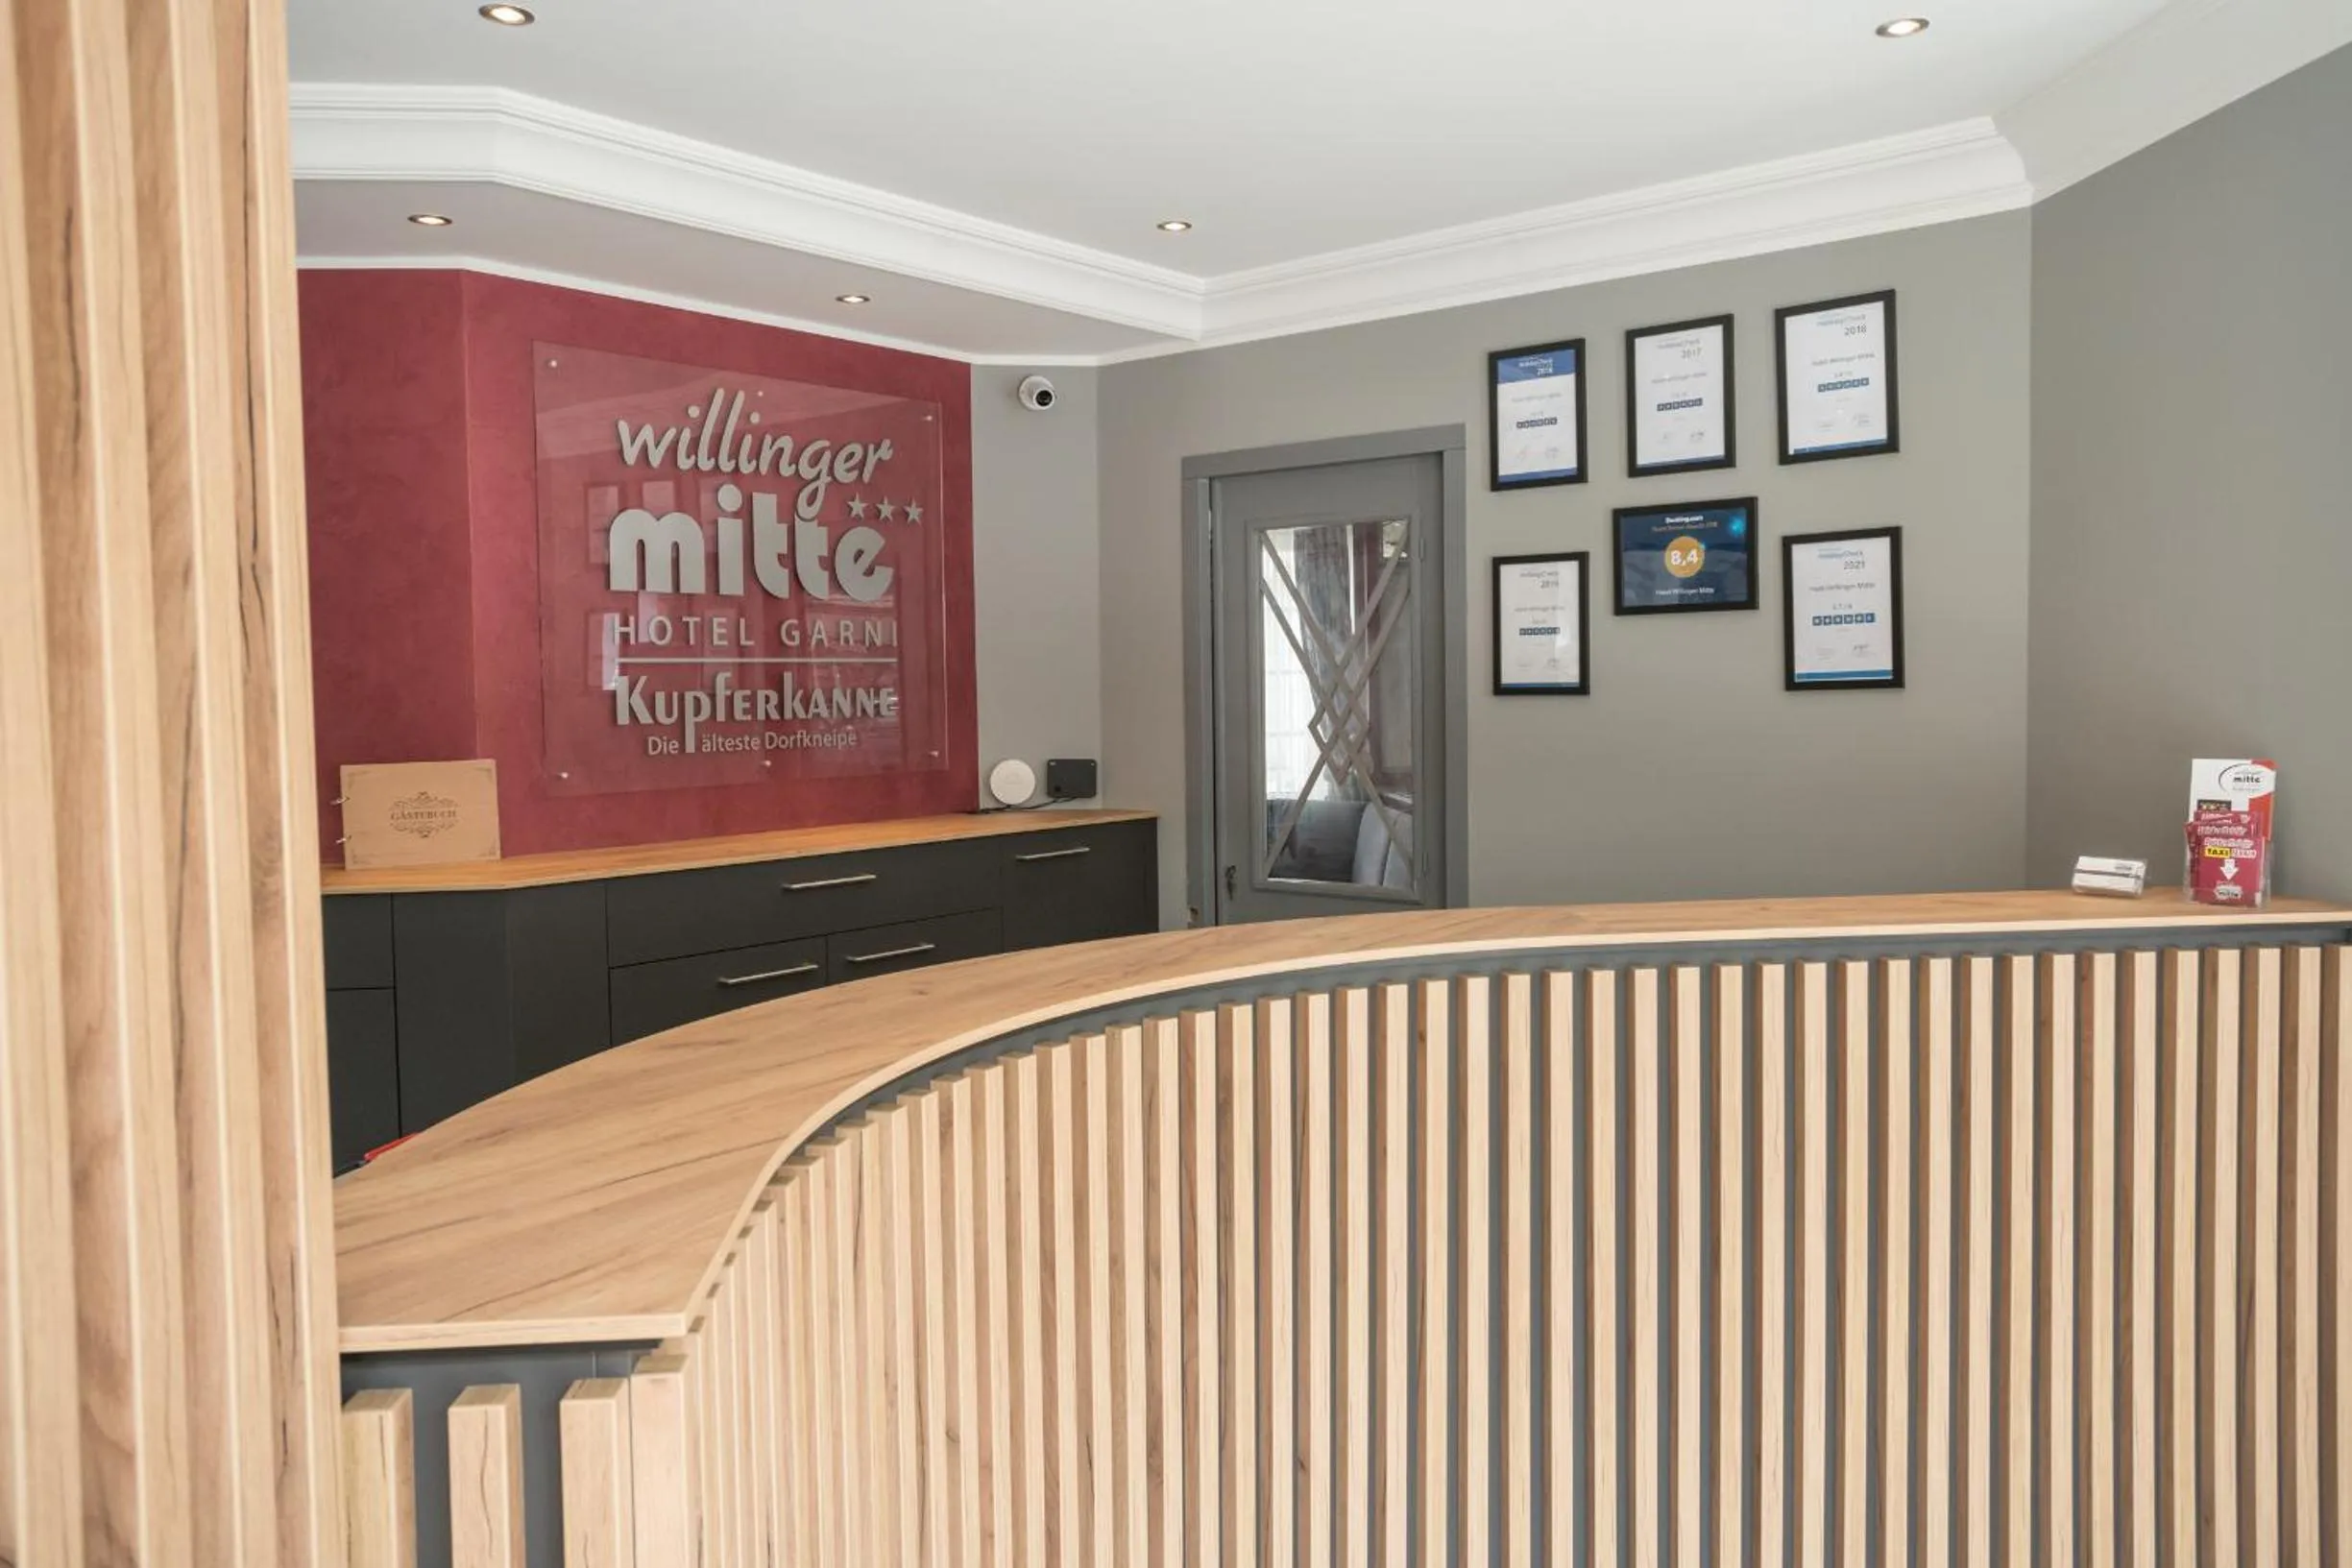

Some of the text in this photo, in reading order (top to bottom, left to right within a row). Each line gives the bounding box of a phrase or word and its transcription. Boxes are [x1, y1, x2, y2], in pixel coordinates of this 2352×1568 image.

[618, 387, 893, 519] willinger
[609, 483, 894, 602] mitte
[1670, 549, 1698, 567] 8,4
[614, 615, 898, 647] HOTEL GARNI
[647, 729, 858, 756] Die älteste Dorfkneipe
